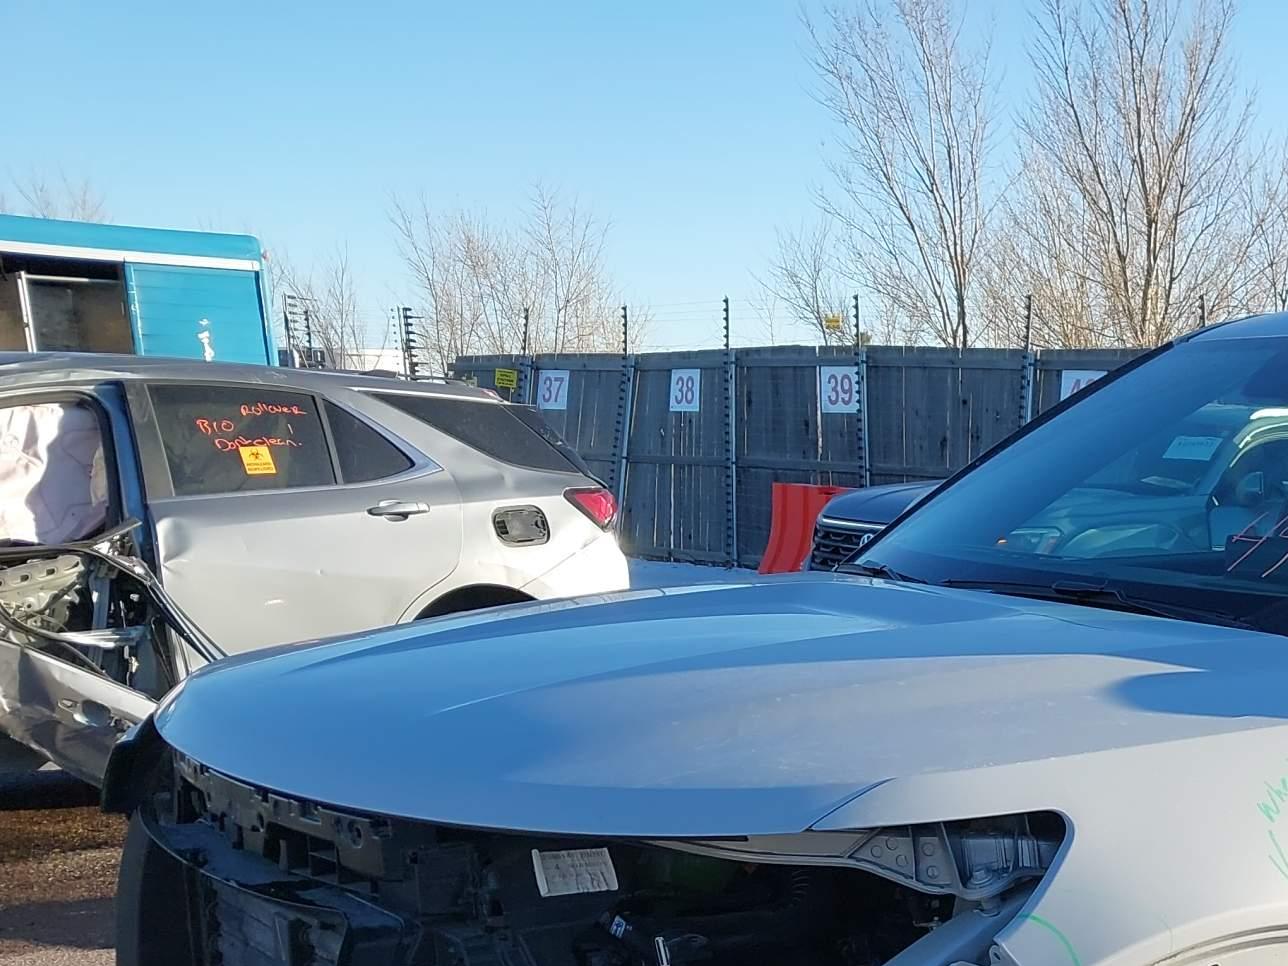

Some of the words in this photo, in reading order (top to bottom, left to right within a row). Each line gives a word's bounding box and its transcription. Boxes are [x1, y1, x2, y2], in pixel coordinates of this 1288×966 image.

[542, 376, 565, 403] 37
[675, 376, 695, 404] 38
[828, 374, 851, 405] 39
